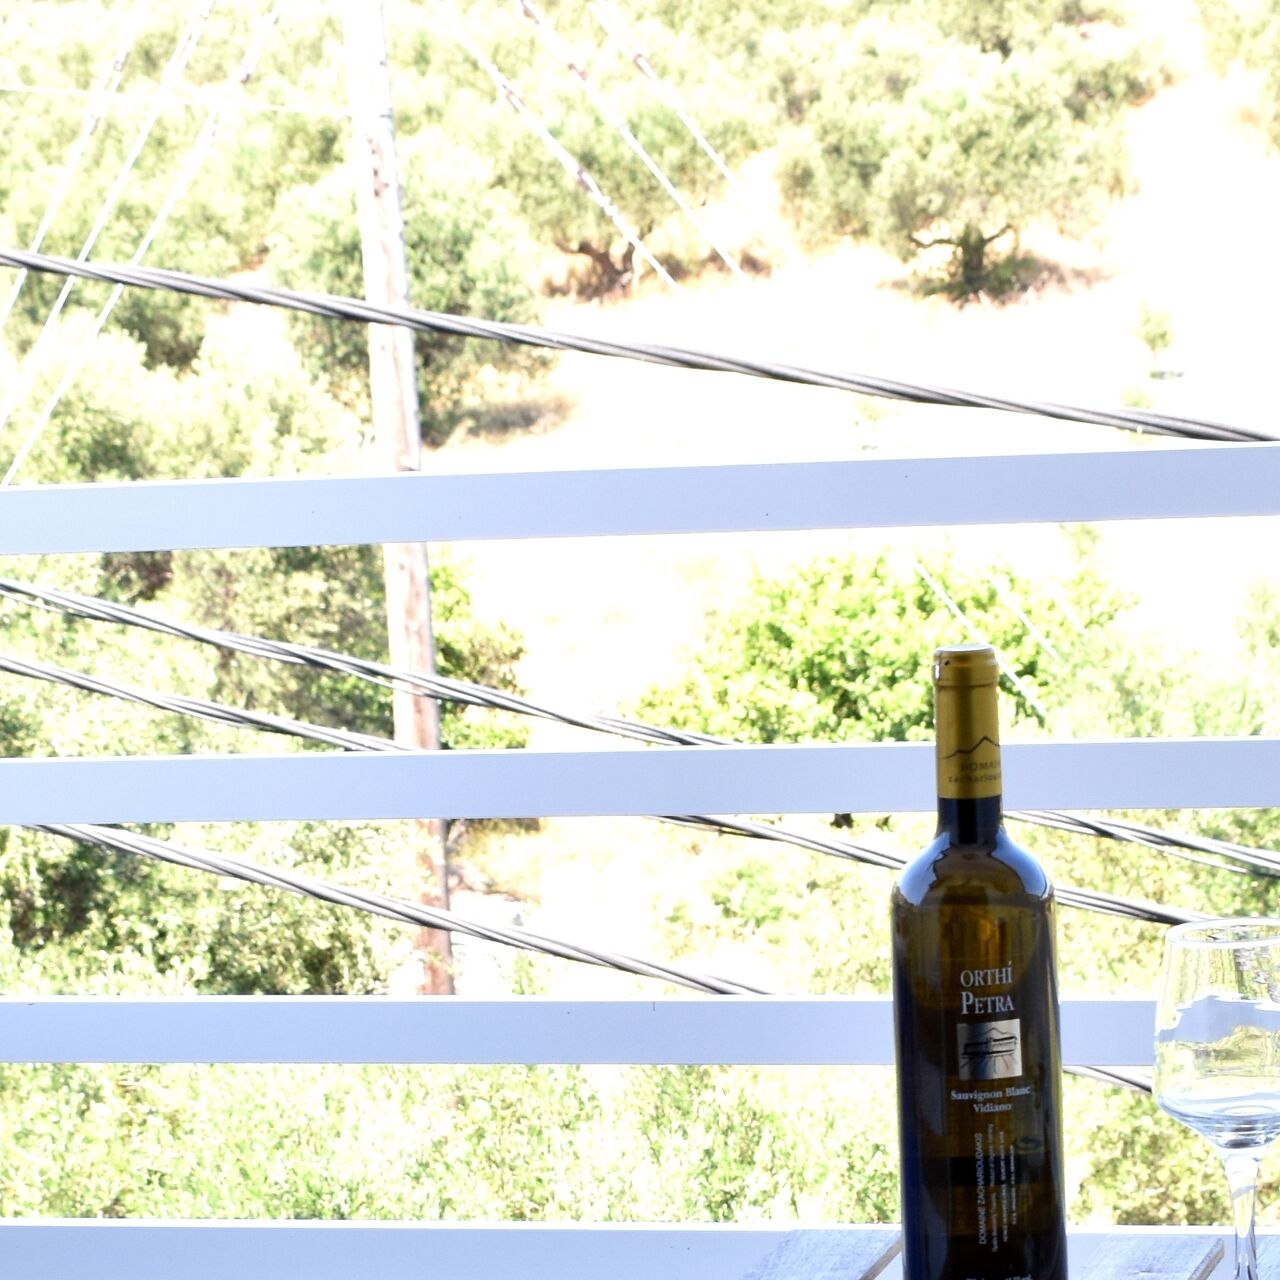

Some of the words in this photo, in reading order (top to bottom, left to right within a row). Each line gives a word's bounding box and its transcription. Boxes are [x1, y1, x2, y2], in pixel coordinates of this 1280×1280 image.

[960, 961, 1013, 988] ORTHÍ
[951, 1090, 1003, 1102] Sauvignon
[1006, 1086, 1031, 1097] Blanc
[973, 1103, 1012, 1113] Vidiano
[974, 1132, 985, 1205] ZACHARIOUDAKIS
[977, 1207, 987, 1244] DOMAINE
